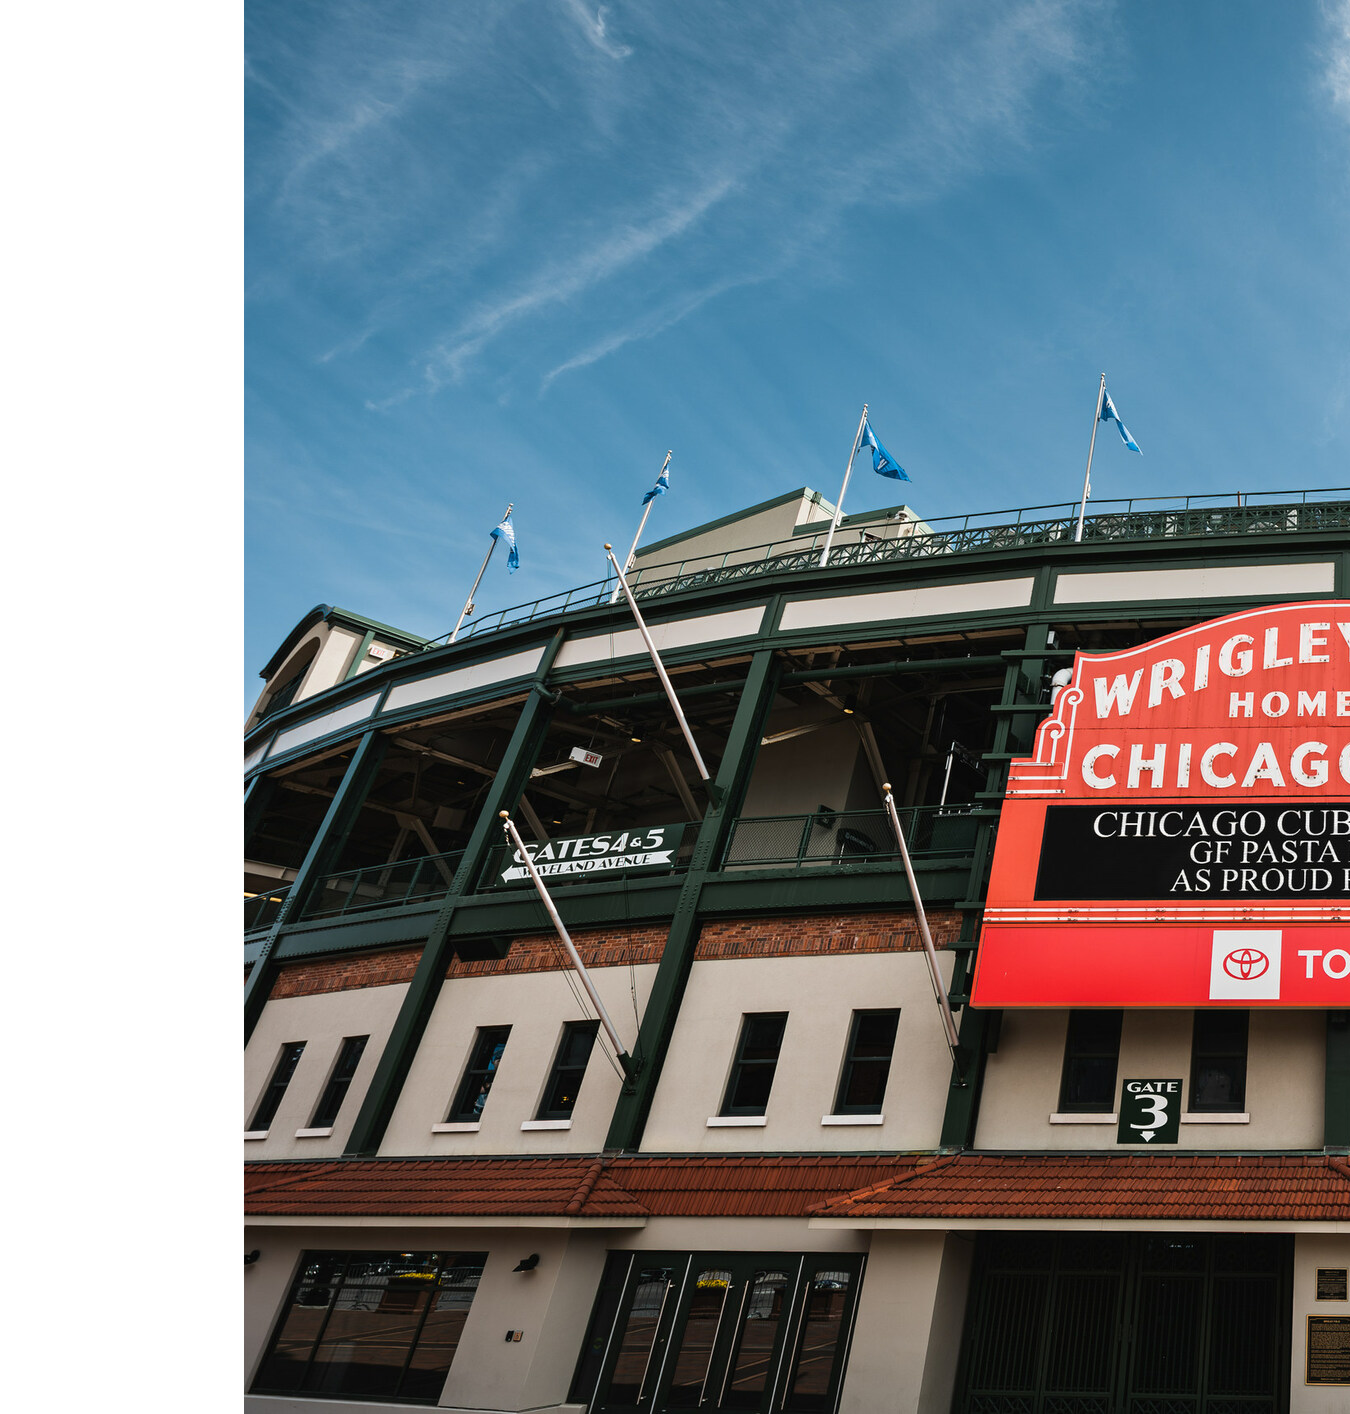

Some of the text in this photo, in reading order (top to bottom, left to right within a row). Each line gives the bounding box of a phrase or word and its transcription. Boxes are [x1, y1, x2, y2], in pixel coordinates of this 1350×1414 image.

[584, 752, 598, 765] EXIT
[1093, 811, 1266, 838] CHICAGO
[597, 854, 653, 869] AVENUE
[1189, 840, 1232, 865] GF
[1239, 840, 1341, 865] PASTA
[1169, 868, 1211, 893] AS
[1220, 868, 1333, 892] PROUD
[1126, 1081, 1179, 1093] GATE
[1129, 1093, 1169, 1130] 3
